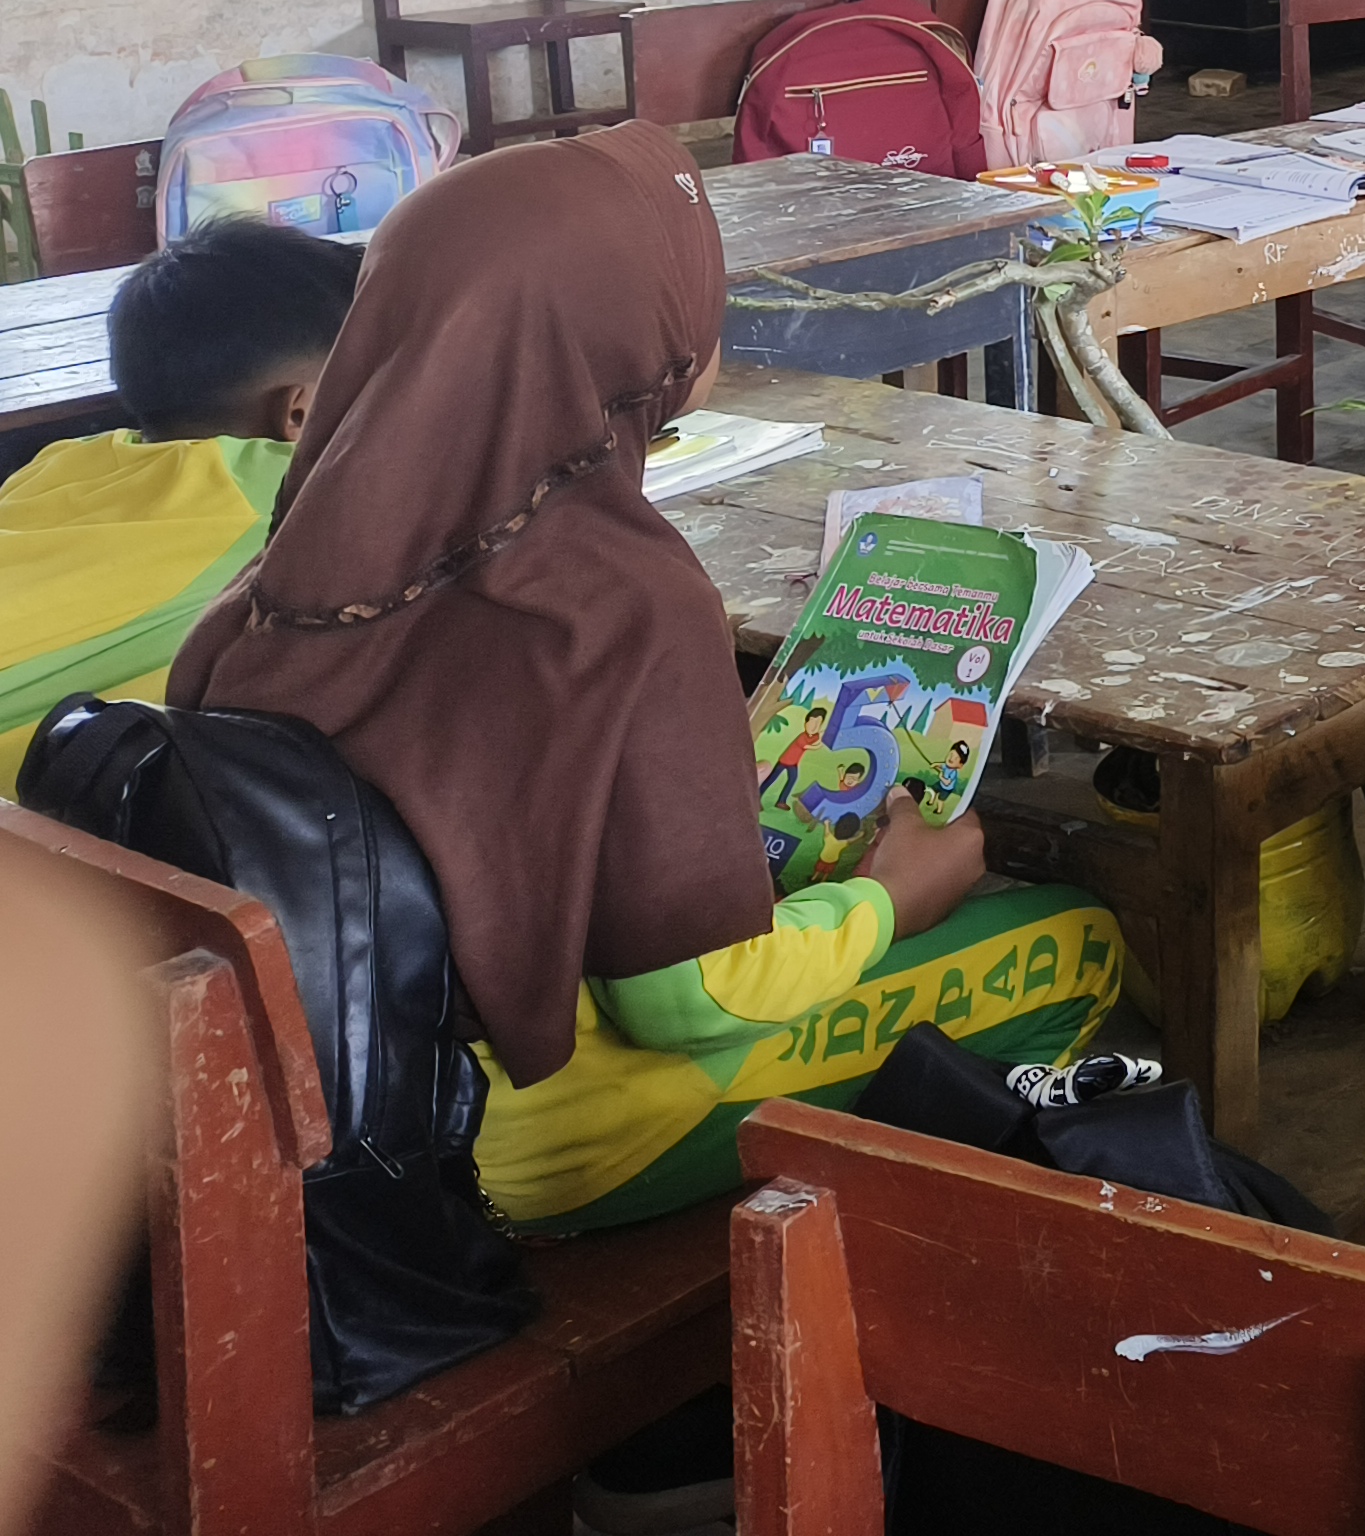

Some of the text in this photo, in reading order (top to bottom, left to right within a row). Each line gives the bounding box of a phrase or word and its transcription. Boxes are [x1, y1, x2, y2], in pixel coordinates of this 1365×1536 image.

[867, 571, 999, 603] Belajar bersama Temanmu
[822, 582, 1016, 644] Matematika
[857, 629, 887, 642] untuk
[967, 653, 986, 665] Vol
[764, 835, 785, 855] 10
